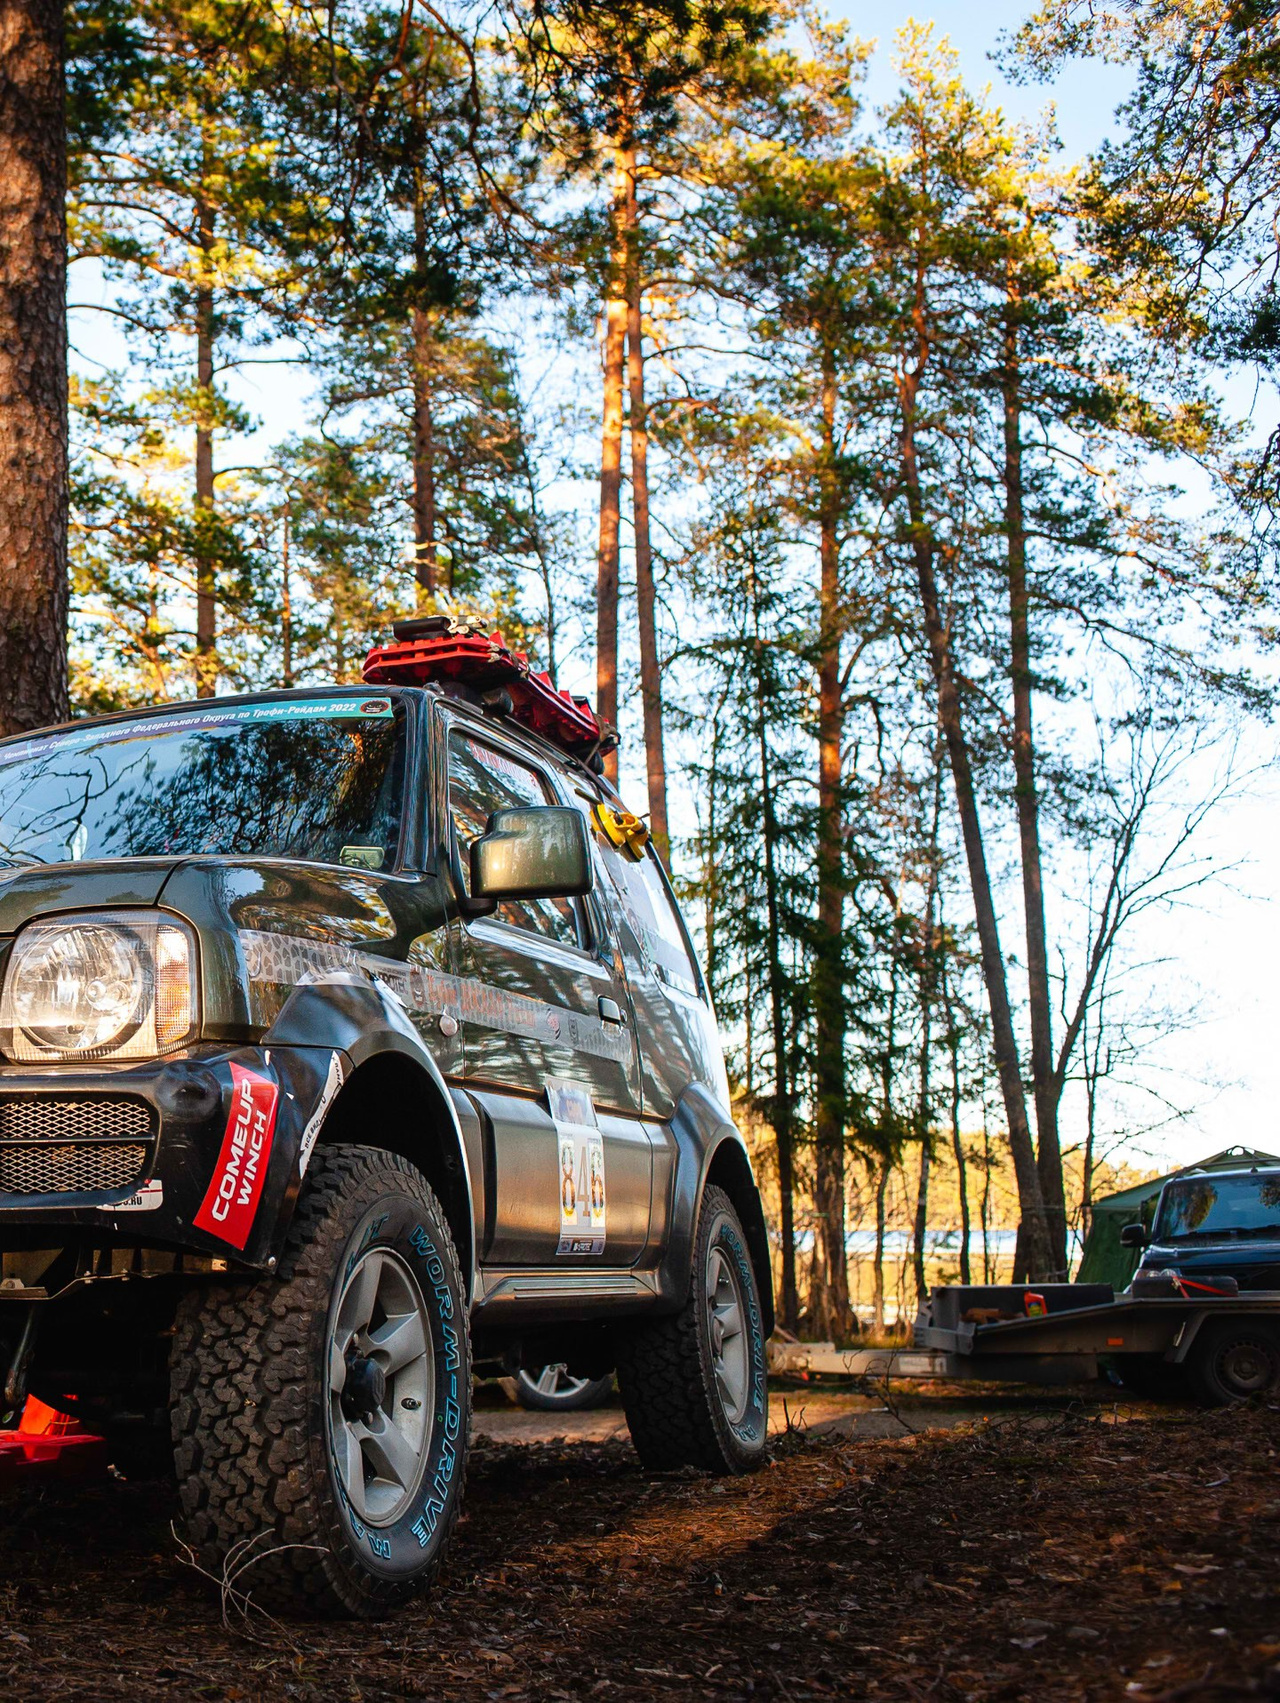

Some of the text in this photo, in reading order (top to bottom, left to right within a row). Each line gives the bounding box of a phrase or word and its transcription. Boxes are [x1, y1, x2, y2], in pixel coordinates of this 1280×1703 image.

[132, 716, 200, 733] Федерального
[202, 713, 236, 725] Округа
[238, 711, 250, 719] по
[252, 703, 327, 718] Трофи-Рейдам
[328, 703, 357, 712] 2022
[211, 1077, 255, 1223] COMEUP
[236, 1109, 268, 1206] WINCH
[409, 1224, 461, 1548] WORM-DRIVE
